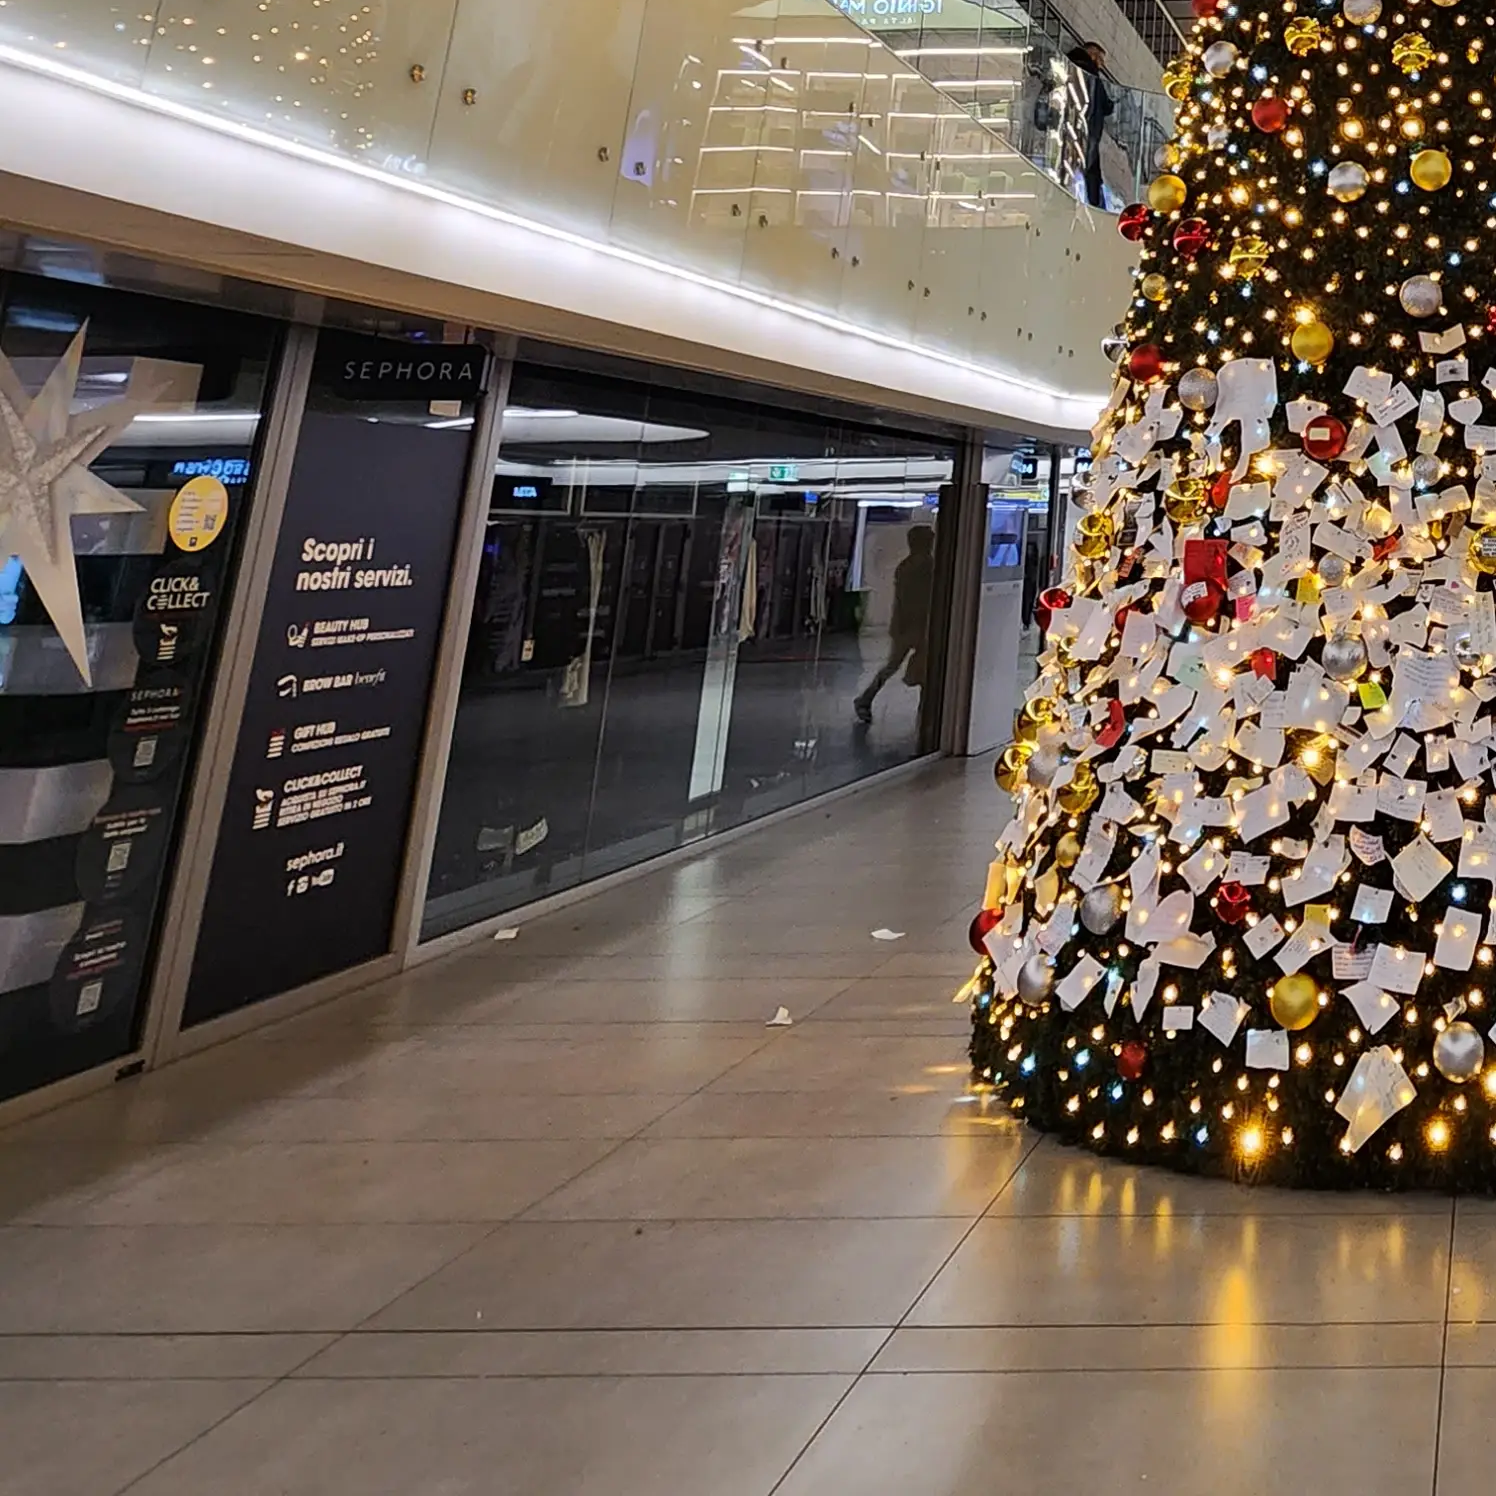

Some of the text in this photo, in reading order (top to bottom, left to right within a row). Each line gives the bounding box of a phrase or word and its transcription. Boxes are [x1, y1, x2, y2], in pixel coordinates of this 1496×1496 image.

[344, 361, 473, 380] SEPHORA
[302, 538, 376, 565] Scopri i
[150, 577, 200, 593] CLICK&
[296, 564, 413, 591] nostri servizi.
[313, 618, 369, 635] BEAUTY HUB
[303, 676, 334, 692] BROW
[333, 674, 354, 688] BAR
[293, 721, 336, 740] GIFT HUB
[284, 765, 363, 792] CLICK&COLLECT
[286, 842, 345, 872] sephora.it
